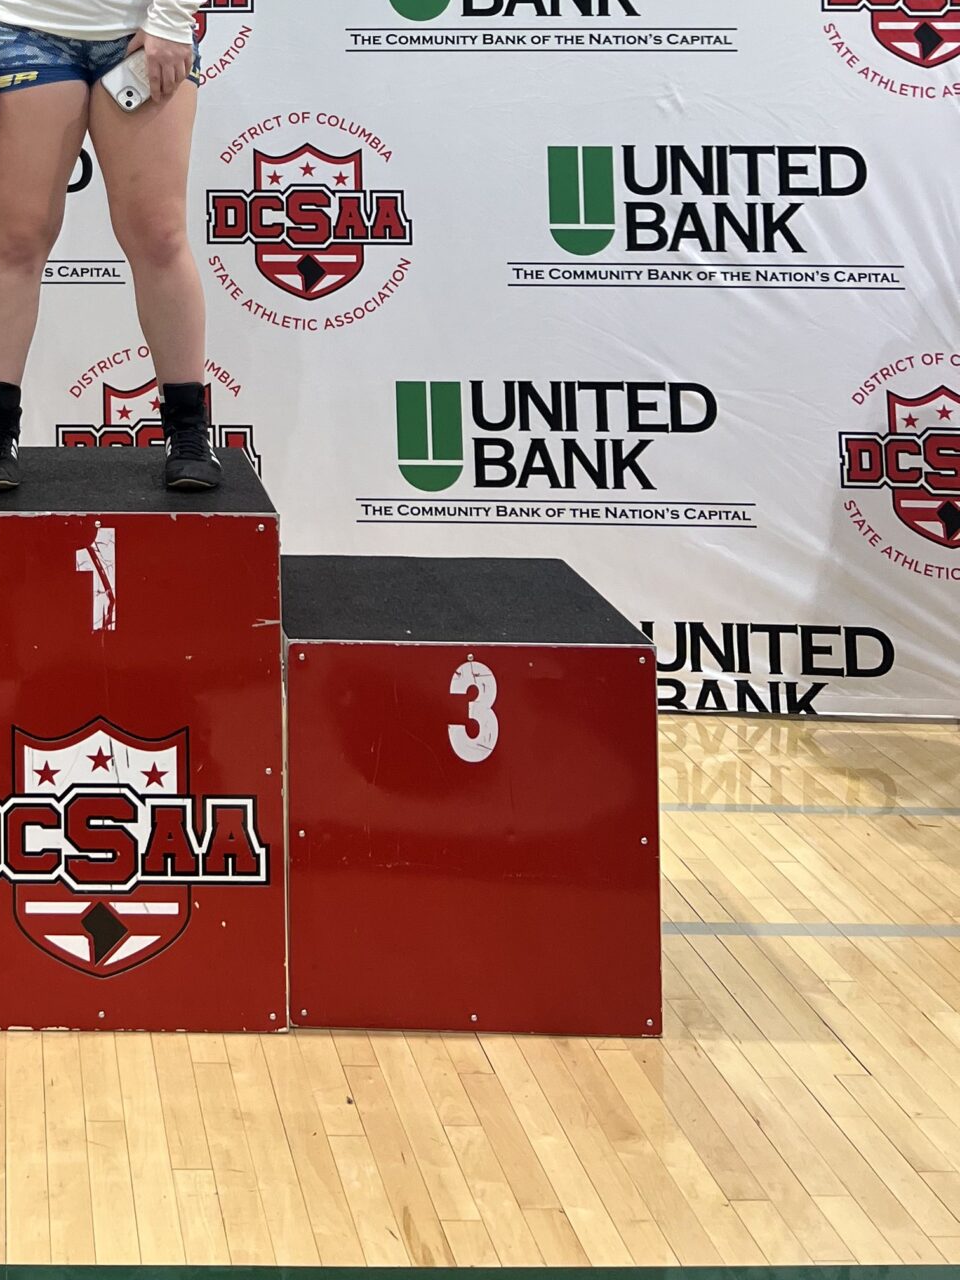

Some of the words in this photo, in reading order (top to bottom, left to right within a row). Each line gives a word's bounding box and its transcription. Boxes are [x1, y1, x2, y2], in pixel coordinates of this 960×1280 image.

[350, 34, 381, 45] THE
[386, 34, 478, 45] COMMUNITY
[483, 34, 526, 44] BANK
[531, 36, 551, 44] OF
[555, 35, 584, 44] THE
[667, 34, 732, 44] CAPITAL
[219, 115, 281, 165] DISTRICT
[286, 111, 310, 126] OF
[315, 112, 393, 161] COLUMBIA
[622, 145, 867, 196] UNITED
[206, 183, 413, 250] DCSAA
[624, 202, 807, 253] BANK
[207, 254, 243, 301] STATE
[242, 298, 319, 333] ATHLETIC
[323, 259, 412, 330] ASSOCIATION
[512, 268, 544, 279] THE
[549, 268, 643, 280] COMMUNITY
[648, 269, 692, 280] BANK
[697, 271, 717, 281] OF
[721, 272, 751, 281] THE
[834, 271, 899, 282] CAPITAL
[469, 380, 717, 433] UNITED
[472, 438, 657, 490] BANK
[361, 504, 393, 515] THE
[397, 505, 491, 516] COMMUNITY
[496, 506, 541, 517] BANK
[546, 508, 566, 518] OF
[570, 508, 600, 518] THE
[684, 508, 751, 521] CAPITAL
[76, 528, 116, 631] 1
[641, 621, 895, 678] UNITED
[448, 661, 499, 763] 3
